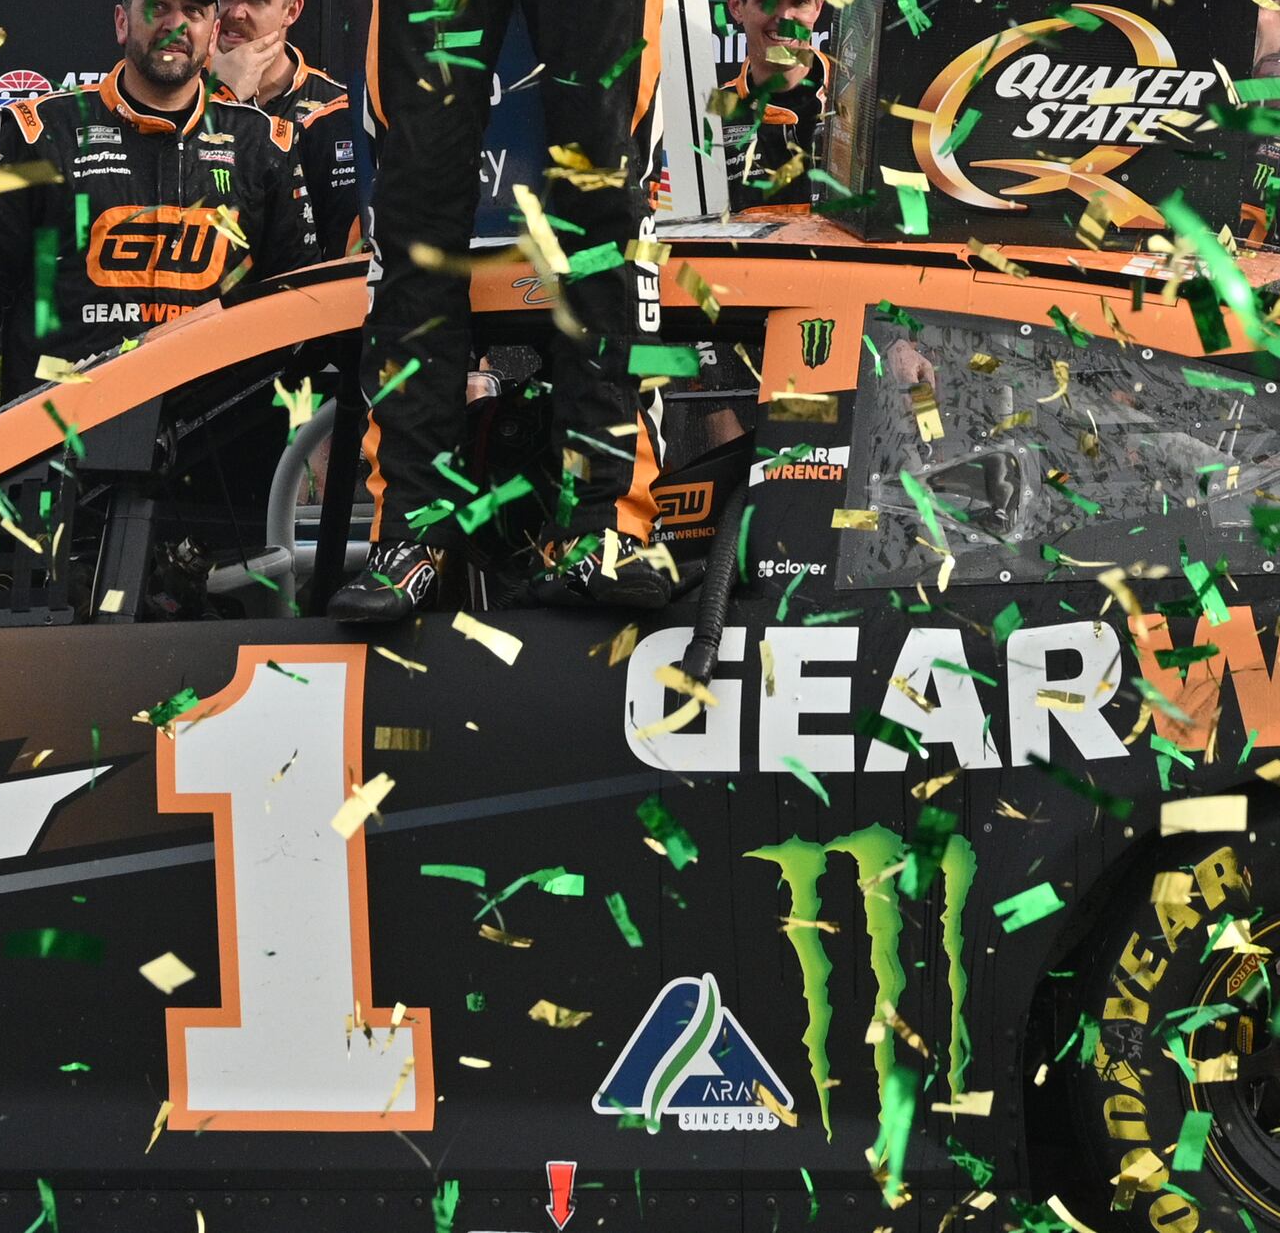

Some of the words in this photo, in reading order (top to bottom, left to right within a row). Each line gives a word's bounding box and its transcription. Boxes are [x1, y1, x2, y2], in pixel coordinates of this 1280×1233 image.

[995, 53, 1217, 107] QUAKER
[764, 463, 843, 480] WRENCH
[775, 559, 827, 576] clover
[157, 644, 434, 1132] 1
[684, 1113, 730, 1125] SINCE
[738, 1112, 775, 1125] 1995
